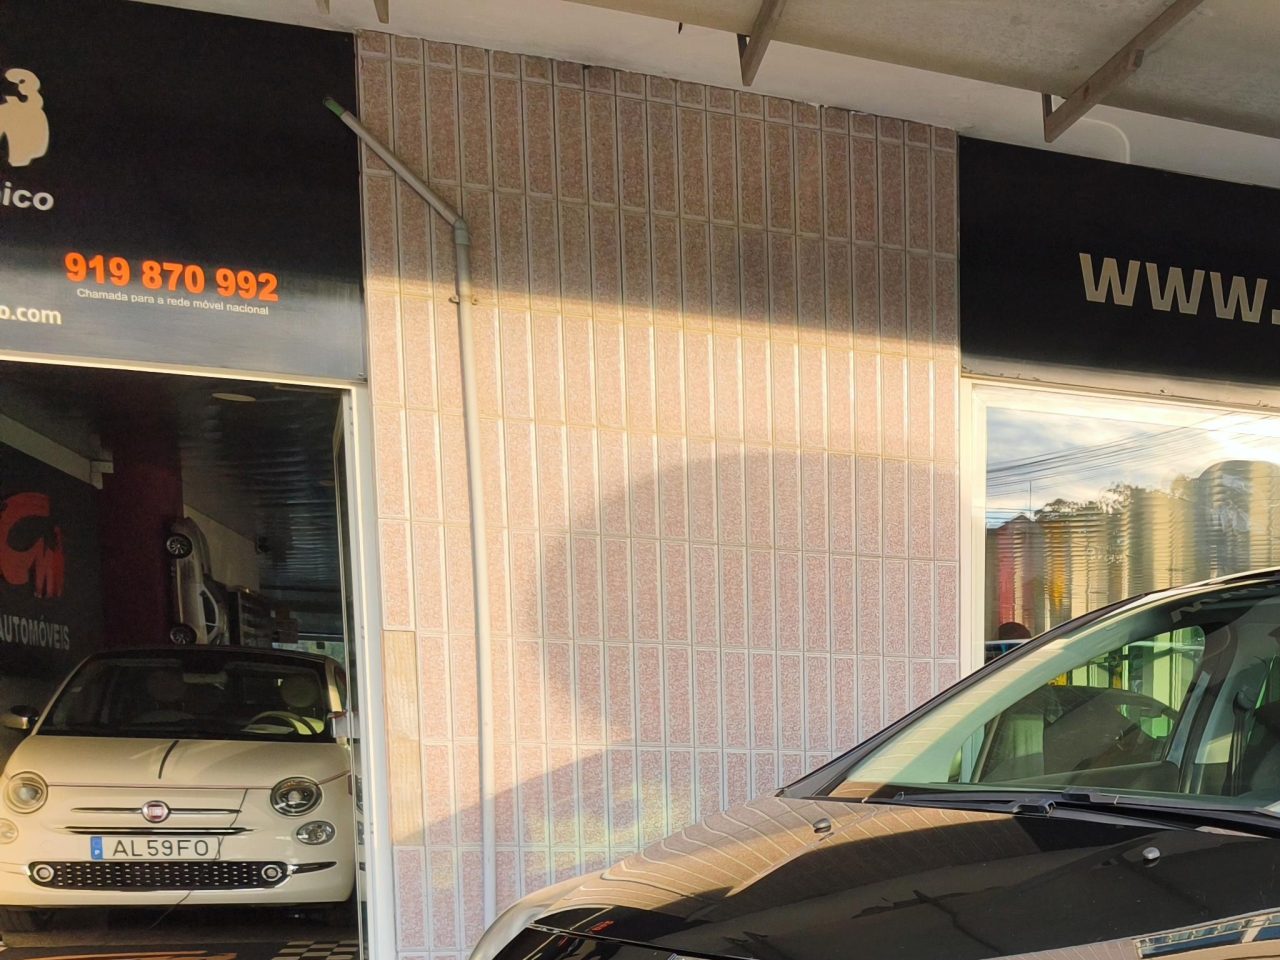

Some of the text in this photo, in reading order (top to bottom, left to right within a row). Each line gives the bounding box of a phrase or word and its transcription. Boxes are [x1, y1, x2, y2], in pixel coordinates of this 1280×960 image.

[0, 181, 54, 211] ico
[65, 252, 279, 302] 919 870 992
[76, 288, 269, 316] Chamada para a rede móvel nacional
